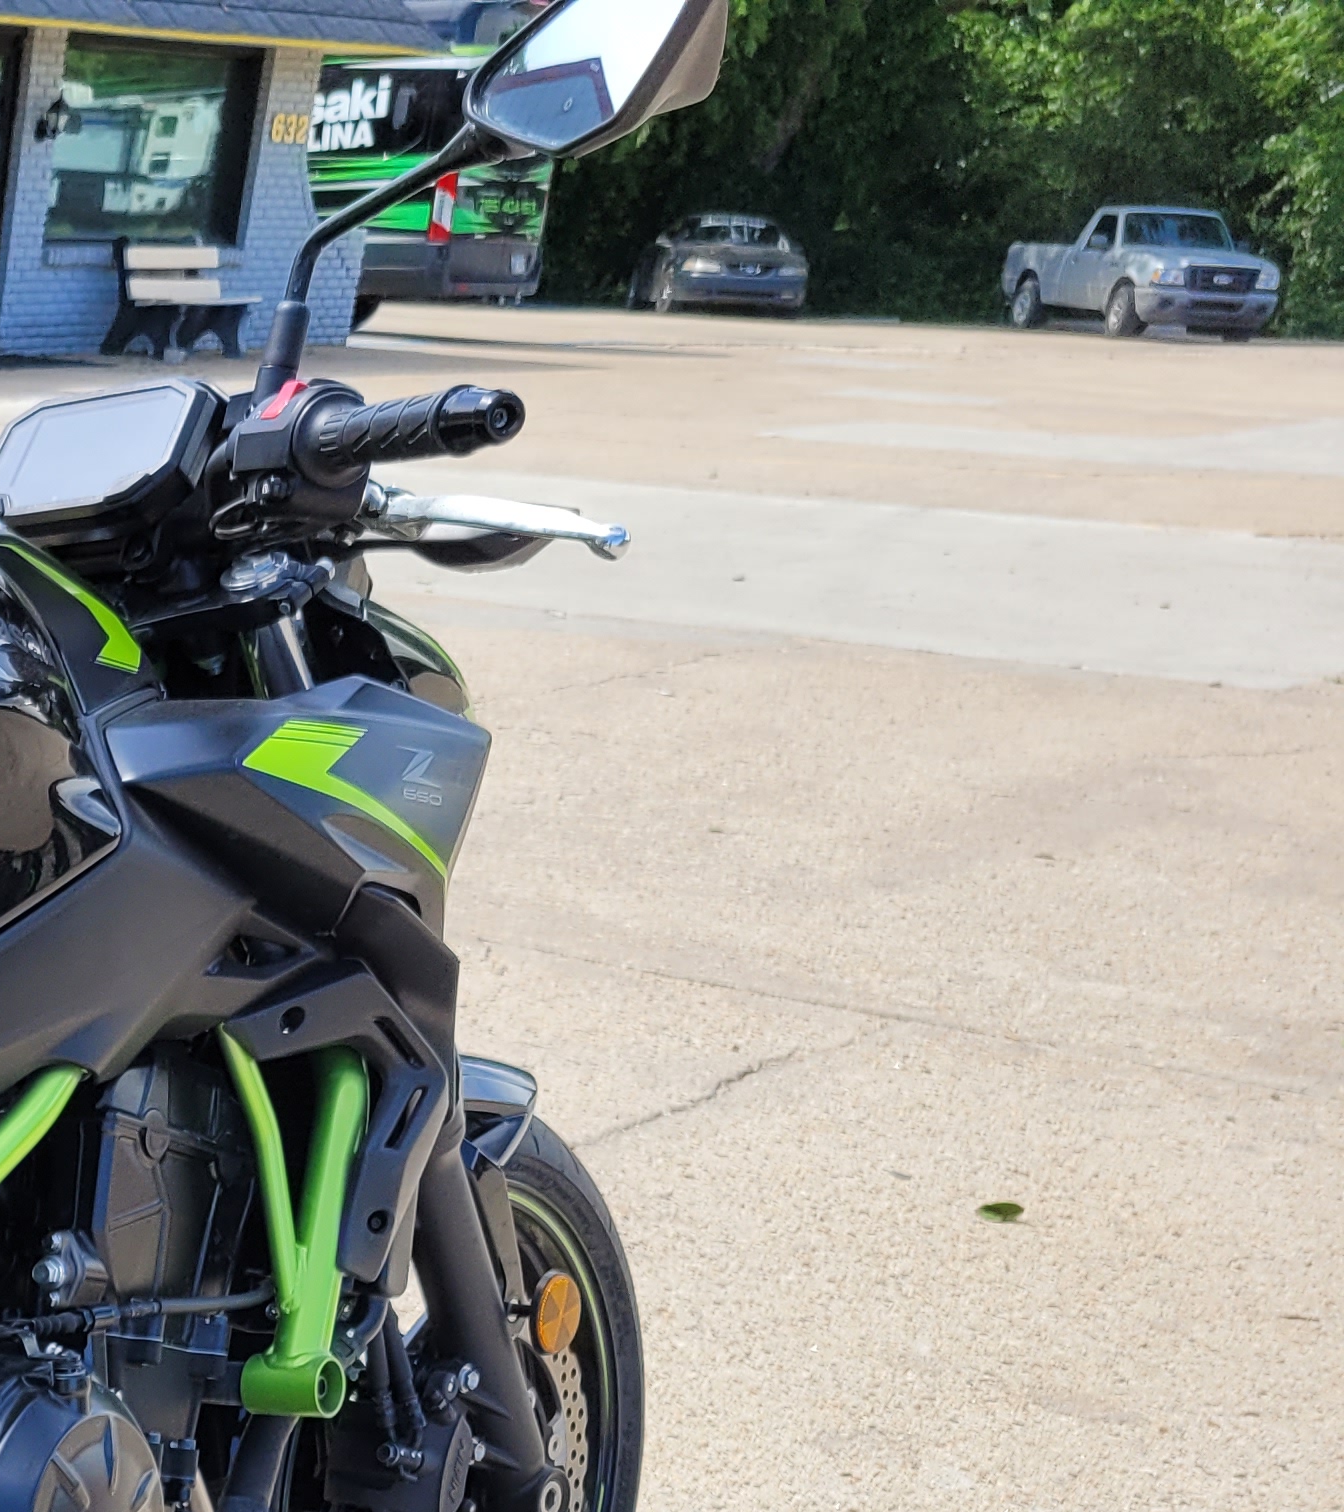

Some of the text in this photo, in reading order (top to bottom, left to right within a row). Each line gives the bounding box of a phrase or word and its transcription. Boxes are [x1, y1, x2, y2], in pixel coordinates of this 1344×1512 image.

[271, 112, 309, 144] 632
[396, 745, 442, 790] Z
[403, 788, 442, 806] 650
